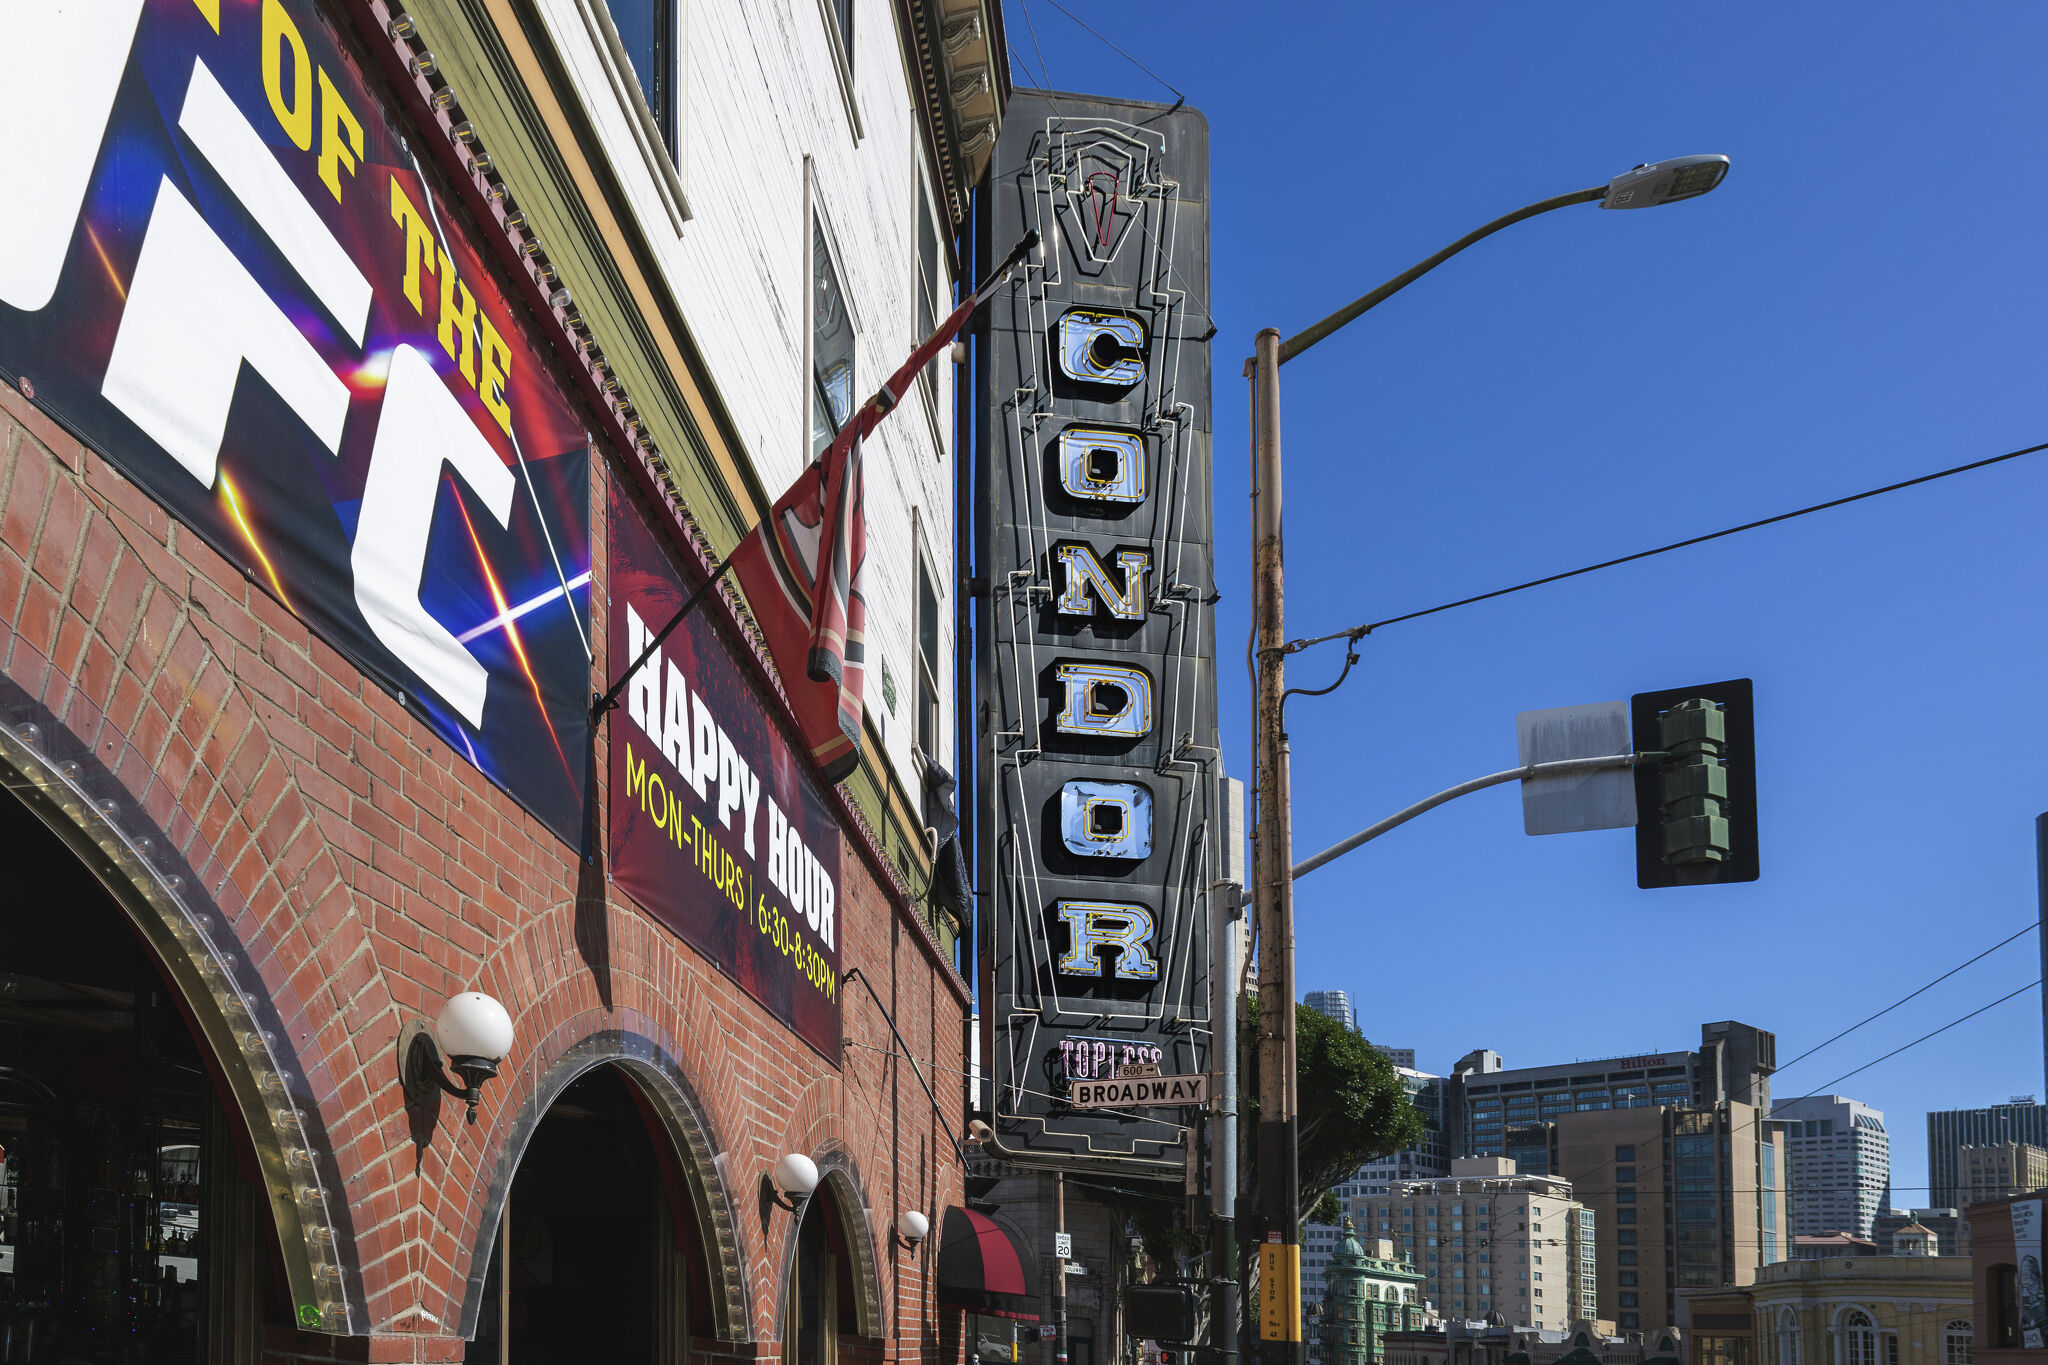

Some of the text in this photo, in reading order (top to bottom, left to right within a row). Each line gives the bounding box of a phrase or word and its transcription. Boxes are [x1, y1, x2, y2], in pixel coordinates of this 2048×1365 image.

[262, 0, 513, 439] OF THE
[1056, 310, 1159, 981] CONDOR
[627, 601, 835, 953] HAPPY HOUR
[626, 742, 744, 911] MON-THURS
[758, 893, 836, 1005] 6:30-8:30PM
[1079, 1080, 1201, 1103] BROADWAY
[1123, 1066, 1142, 1076] 600
[1621, 1057, 1665, 1069] Hilton
[1058, 1246, 1069, 1255] 20
